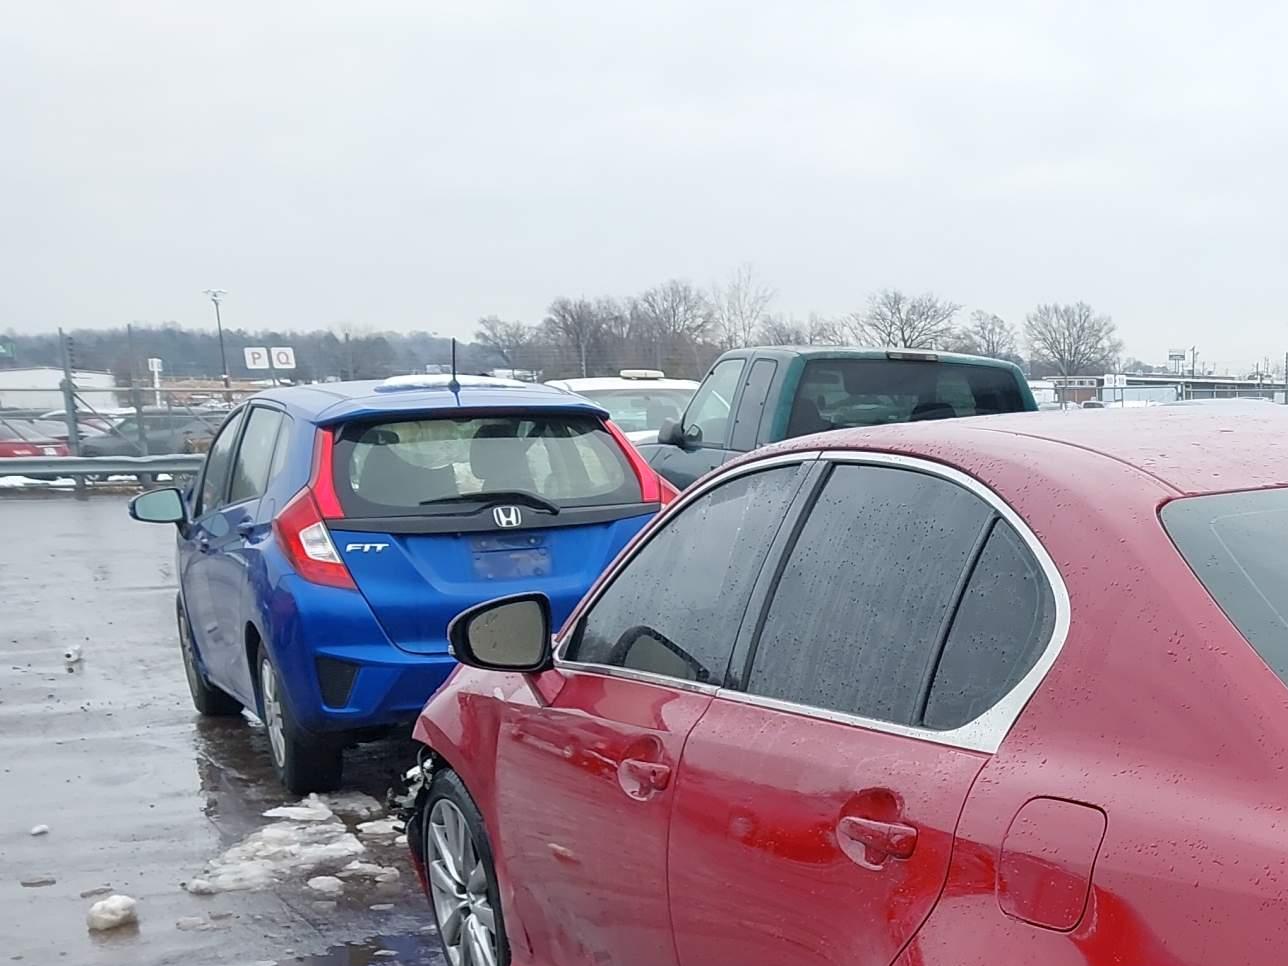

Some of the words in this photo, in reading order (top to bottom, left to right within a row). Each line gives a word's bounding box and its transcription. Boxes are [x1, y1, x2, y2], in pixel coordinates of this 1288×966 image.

[250, 351, 262, 366] P
[276, 351, 292, 366] Q
[345, 543, 390, 553] FIT
